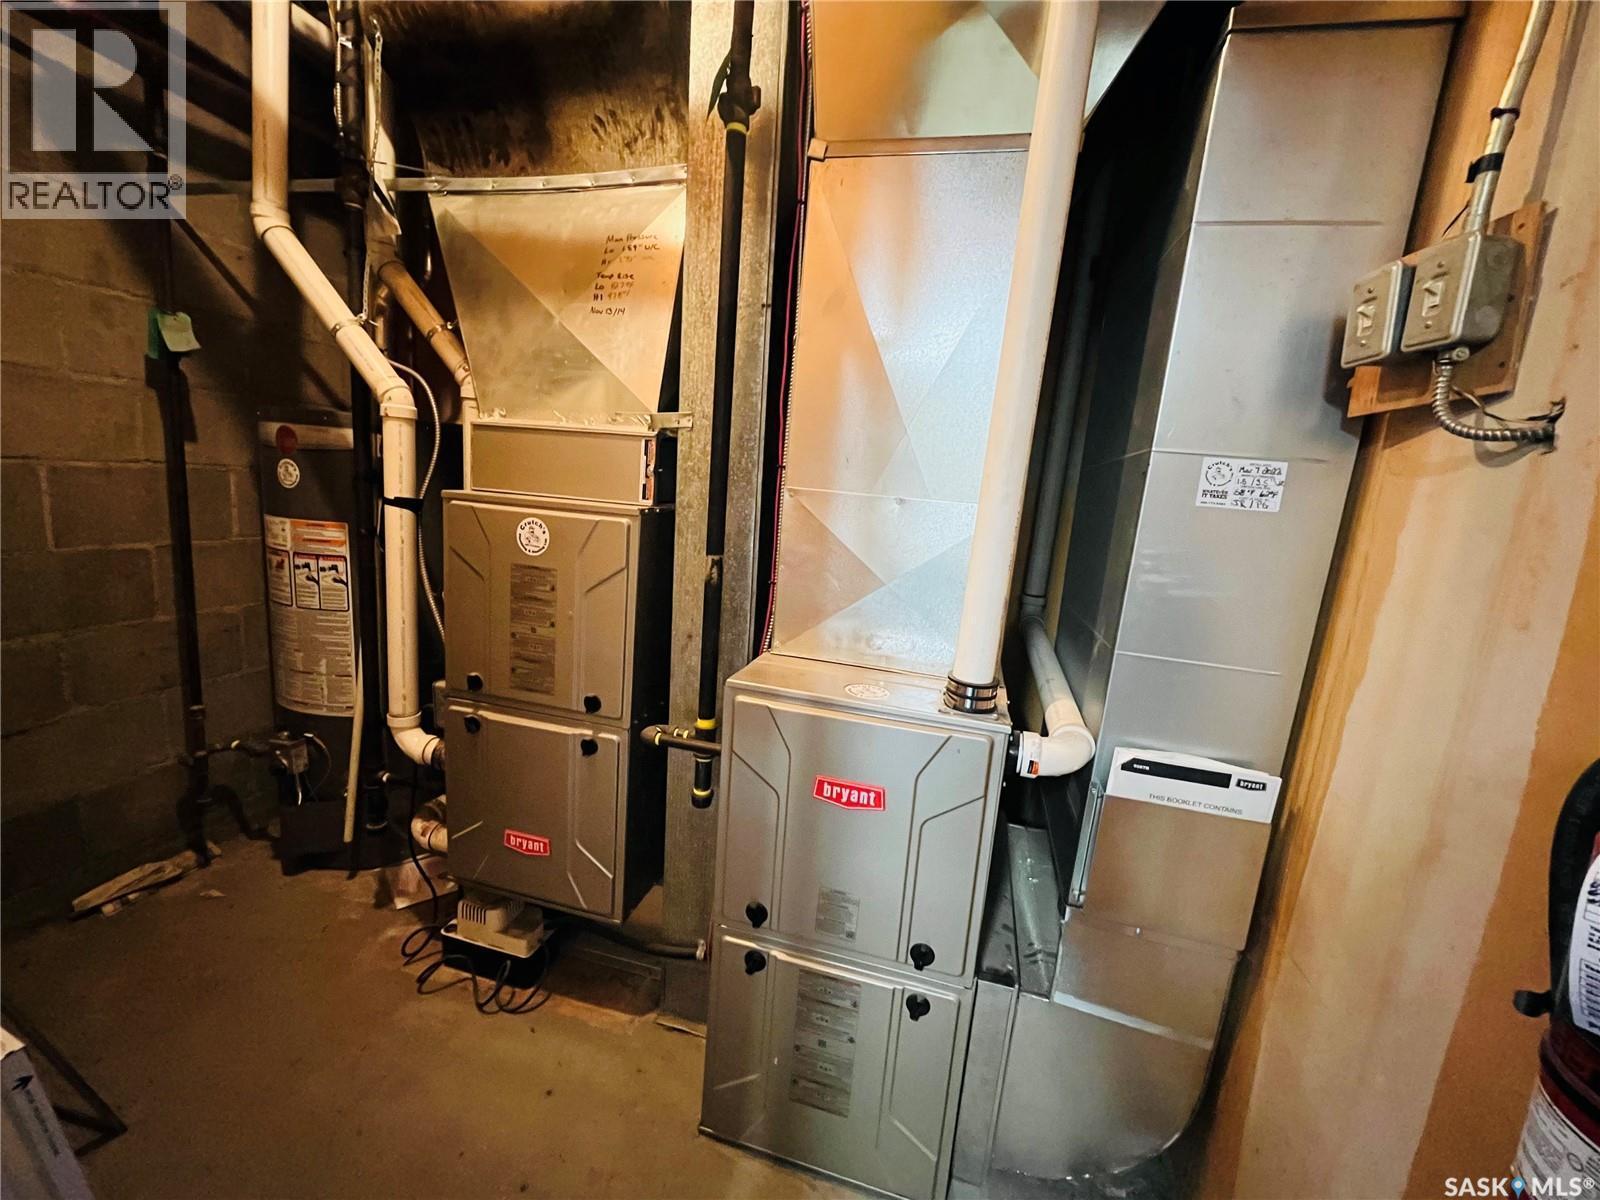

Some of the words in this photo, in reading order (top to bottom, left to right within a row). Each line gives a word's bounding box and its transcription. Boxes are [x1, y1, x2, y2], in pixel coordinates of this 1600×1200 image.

[822, 781, 876, 806] bryant
[1239, 779, 1264, 791] bryant
[1149, 793, 1165, 801] THIS
[1166, 796, 1202, 807] BOOKLET
[1203, 803, 1243, 815] CONTAINS
[510, 834, 544, 853] bryant
